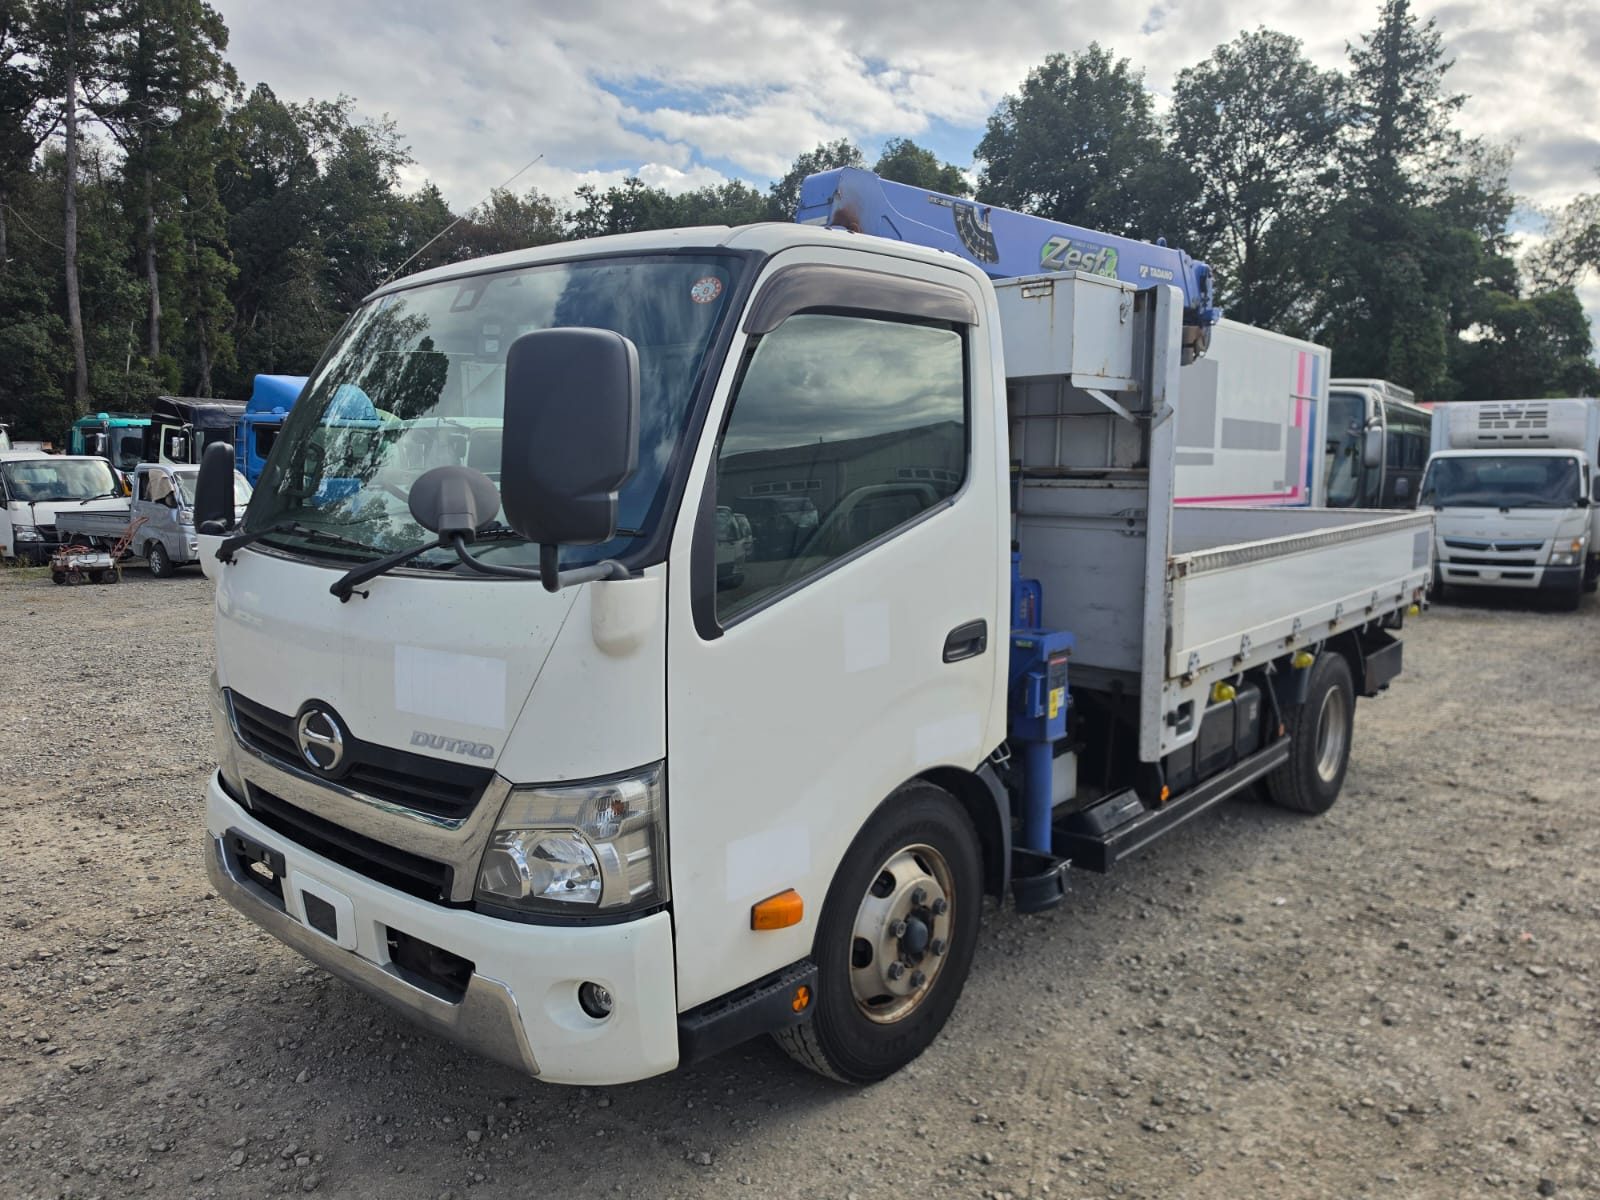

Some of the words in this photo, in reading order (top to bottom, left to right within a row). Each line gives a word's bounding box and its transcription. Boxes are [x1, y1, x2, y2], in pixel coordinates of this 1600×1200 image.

[1041, 236, 1108, 273] Zest
[1150, 266, 1174, 280] TADANO
[410, 730, 495, 759] DUTRO
